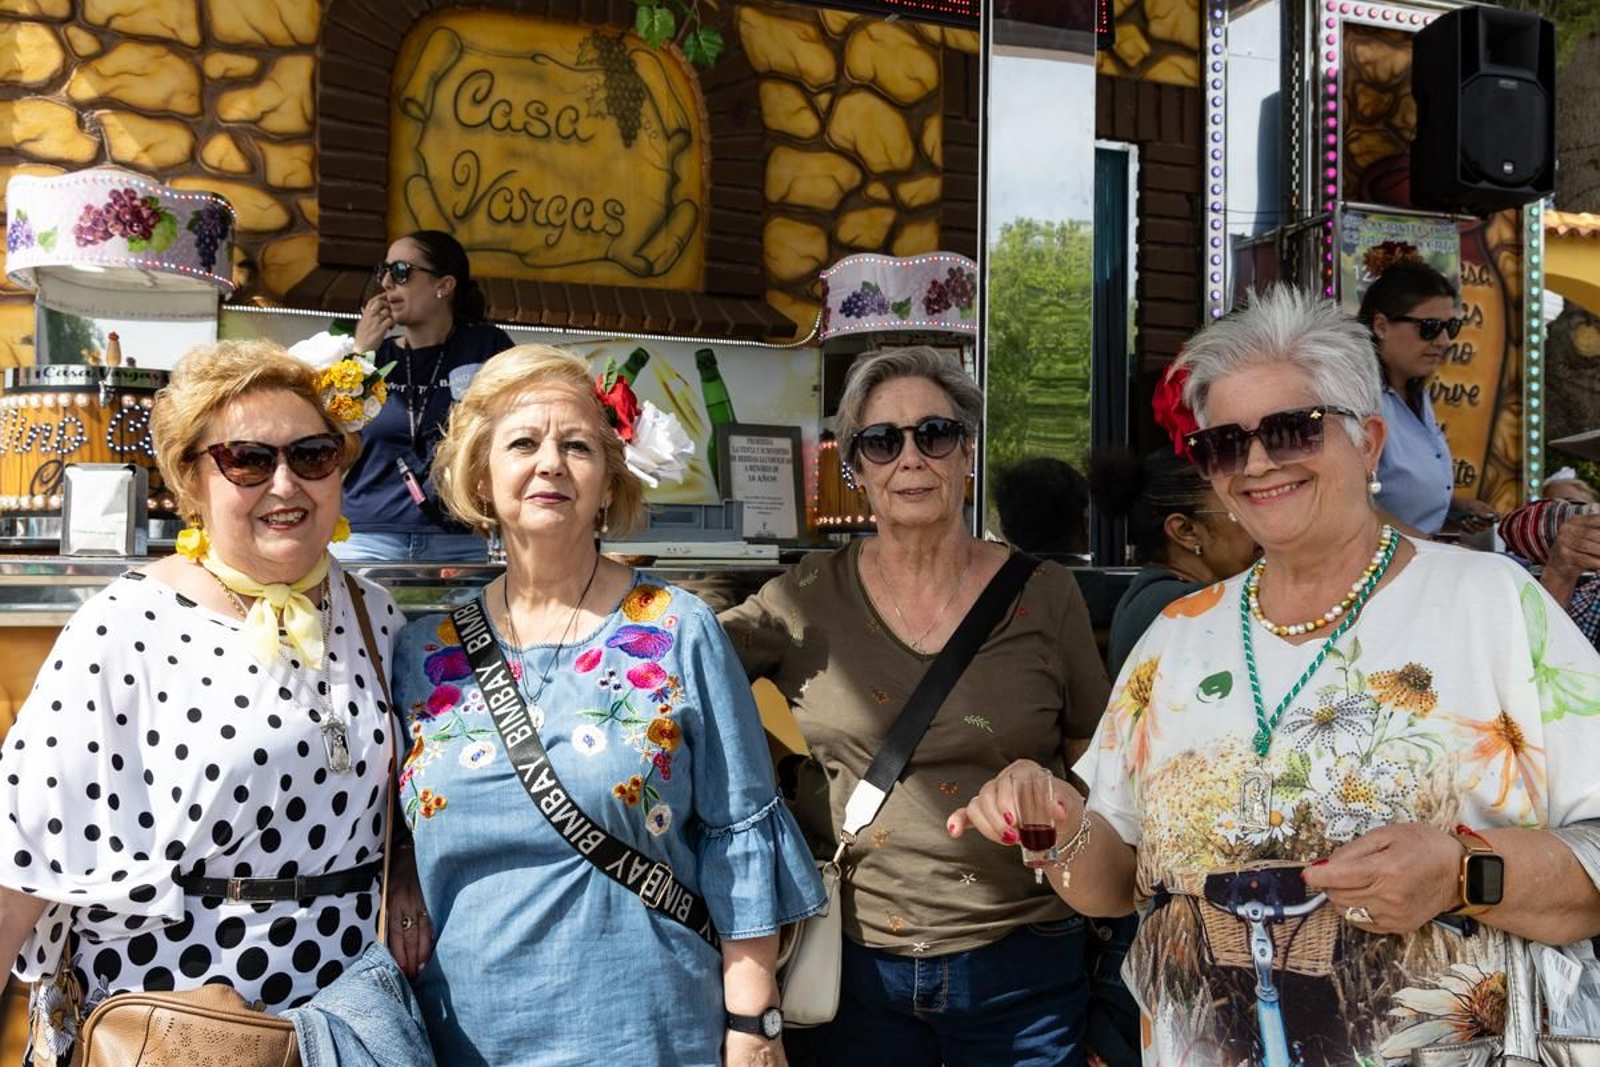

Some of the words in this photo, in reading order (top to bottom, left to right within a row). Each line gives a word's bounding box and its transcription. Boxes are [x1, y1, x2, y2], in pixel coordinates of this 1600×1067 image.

[453, 69, 597, 143] Casa
[452, 149, 625, 247] Vargas
[1429, 375, 1481, 406] irve
[453, 600, 493, 655] BIMB
[475, 660, 533, 749] BIMBAY
[517, 756, 607, 855] BIMBAY
